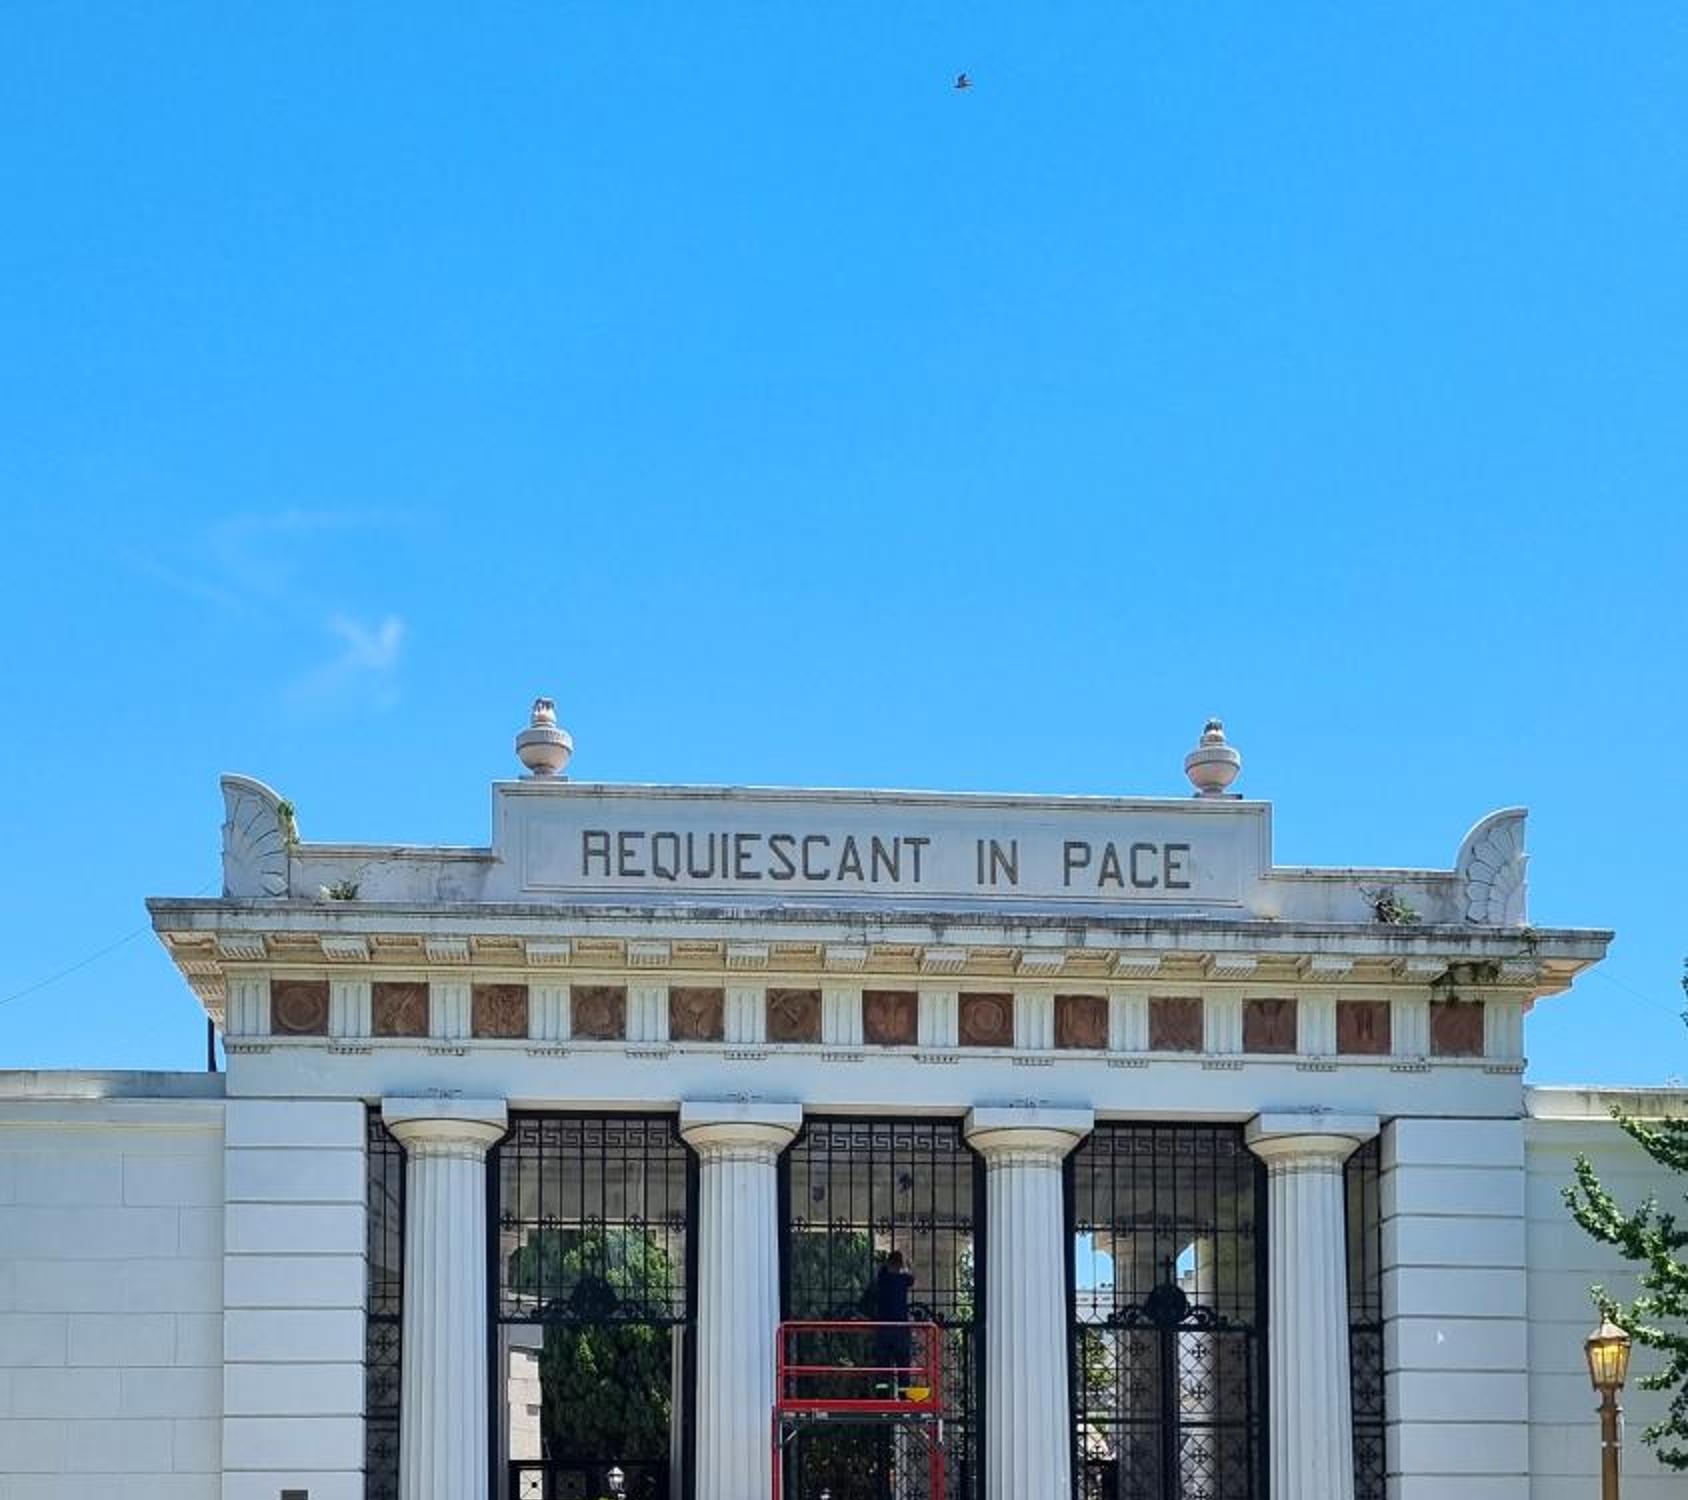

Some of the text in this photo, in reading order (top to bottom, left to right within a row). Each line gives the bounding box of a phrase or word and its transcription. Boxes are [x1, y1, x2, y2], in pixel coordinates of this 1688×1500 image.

[582, 829, 1191, 889] REQUIESCANT IN PACE
